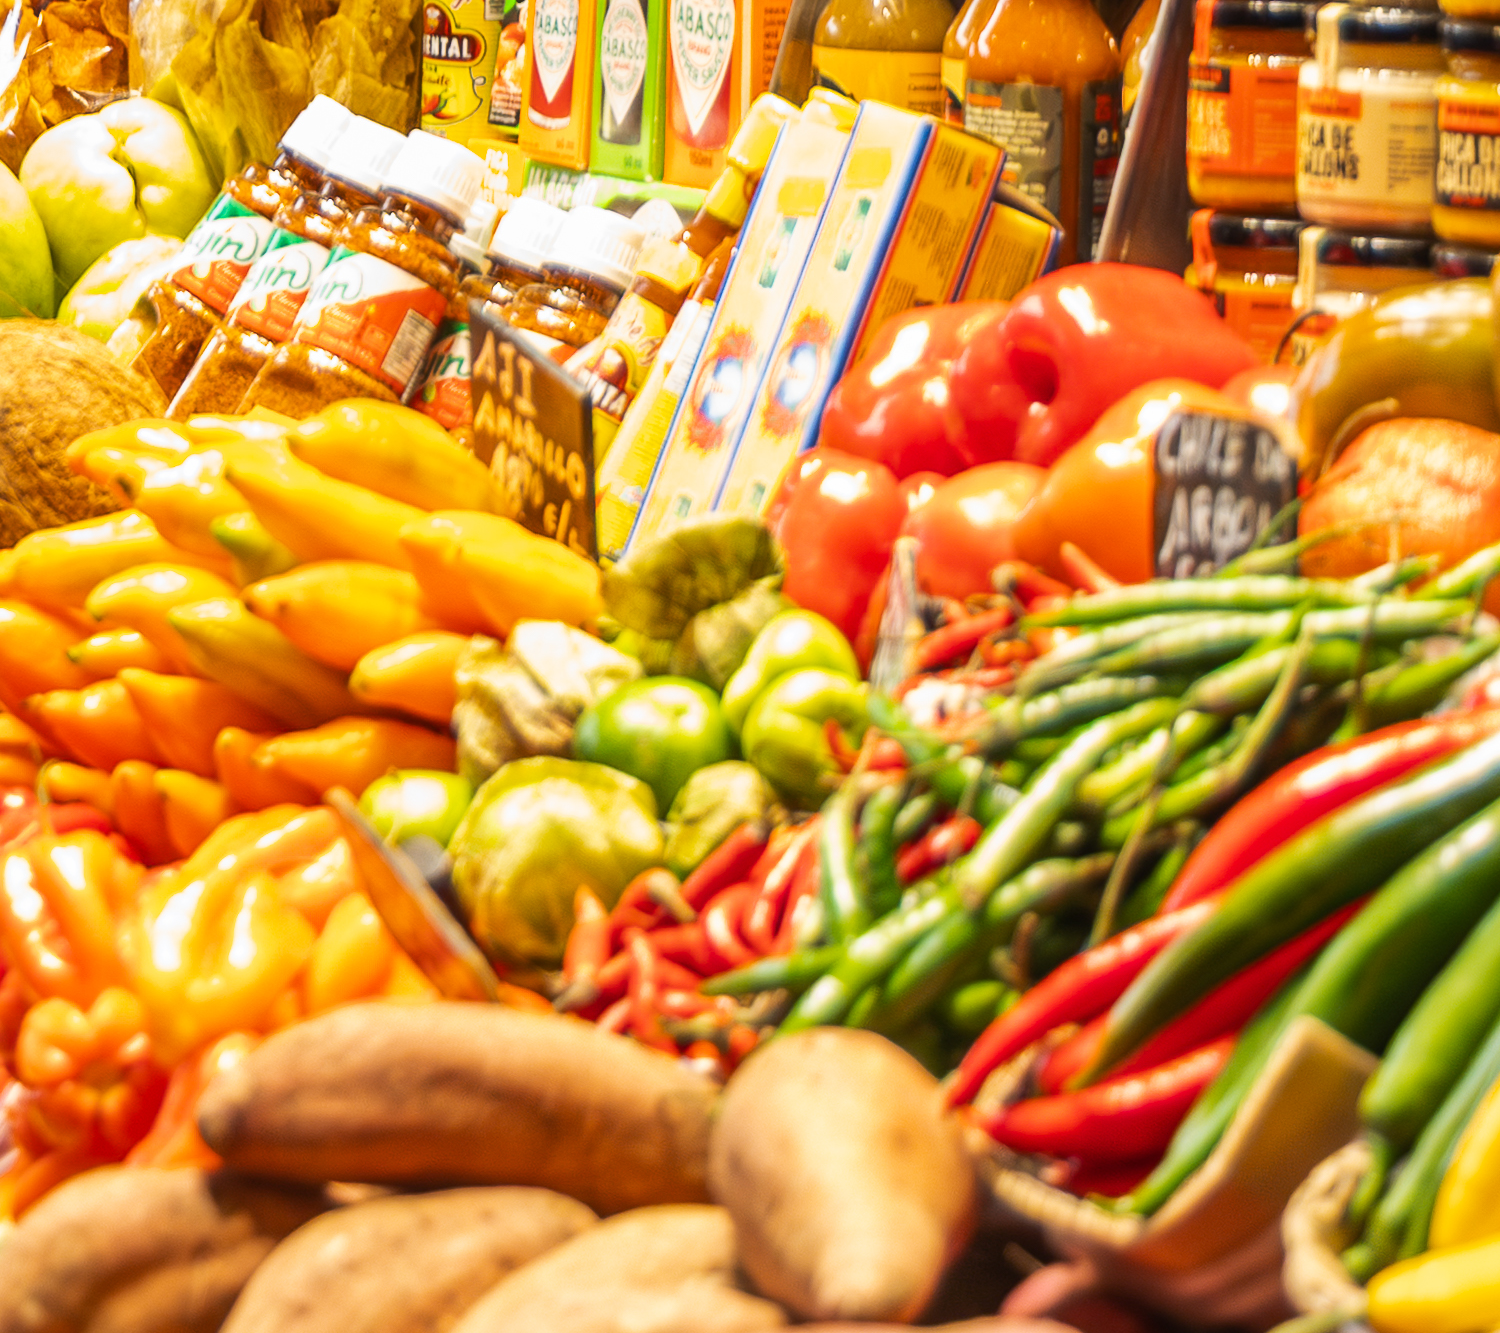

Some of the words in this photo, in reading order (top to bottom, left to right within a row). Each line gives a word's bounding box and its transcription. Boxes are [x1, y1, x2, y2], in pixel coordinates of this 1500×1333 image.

[534, 9, 578, 38] TABASCO
[424, 35, 473, 61] ENTAL
[601, 35, 647, 61] TABASCO
[1159, 415, 1246, 472] CHILE
